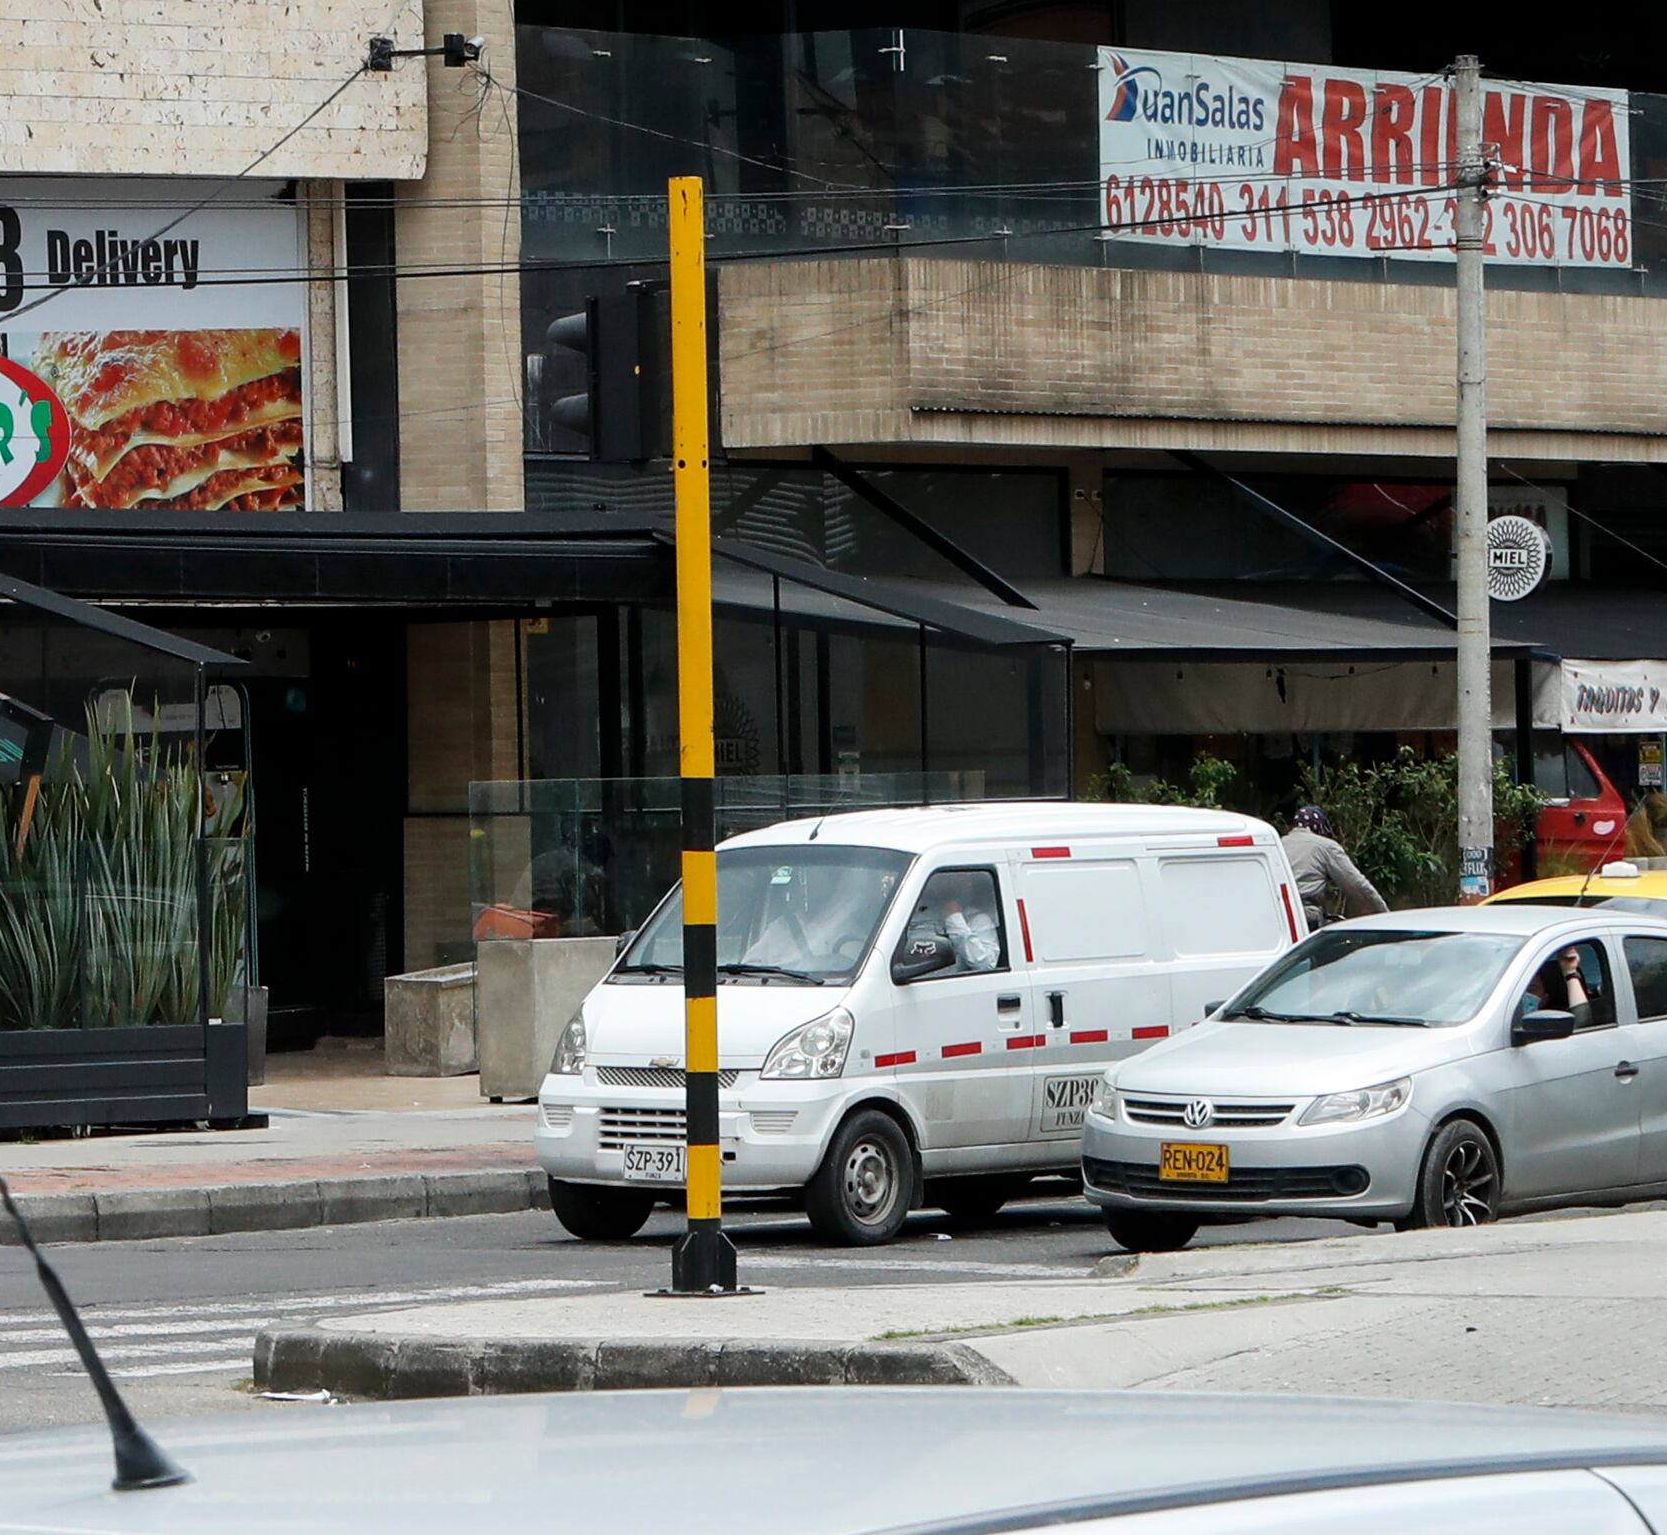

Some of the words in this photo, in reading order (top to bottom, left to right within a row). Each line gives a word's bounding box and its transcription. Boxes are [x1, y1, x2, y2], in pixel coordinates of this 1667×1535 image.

[1147, 138, 1264, 168] INMOBILIARIA
[1302, 188, 1355, 248] 538
[1503, 202, 1555, 259] 306
[1562, 206, 1628, 262] 7068
[46, 228, 200, 290] Delivery
[1493, 551, 1525, 564] MIEL
[1577, 684, 1644, 714] TAQUITOS
[715, 741, 743, 763] IEL
